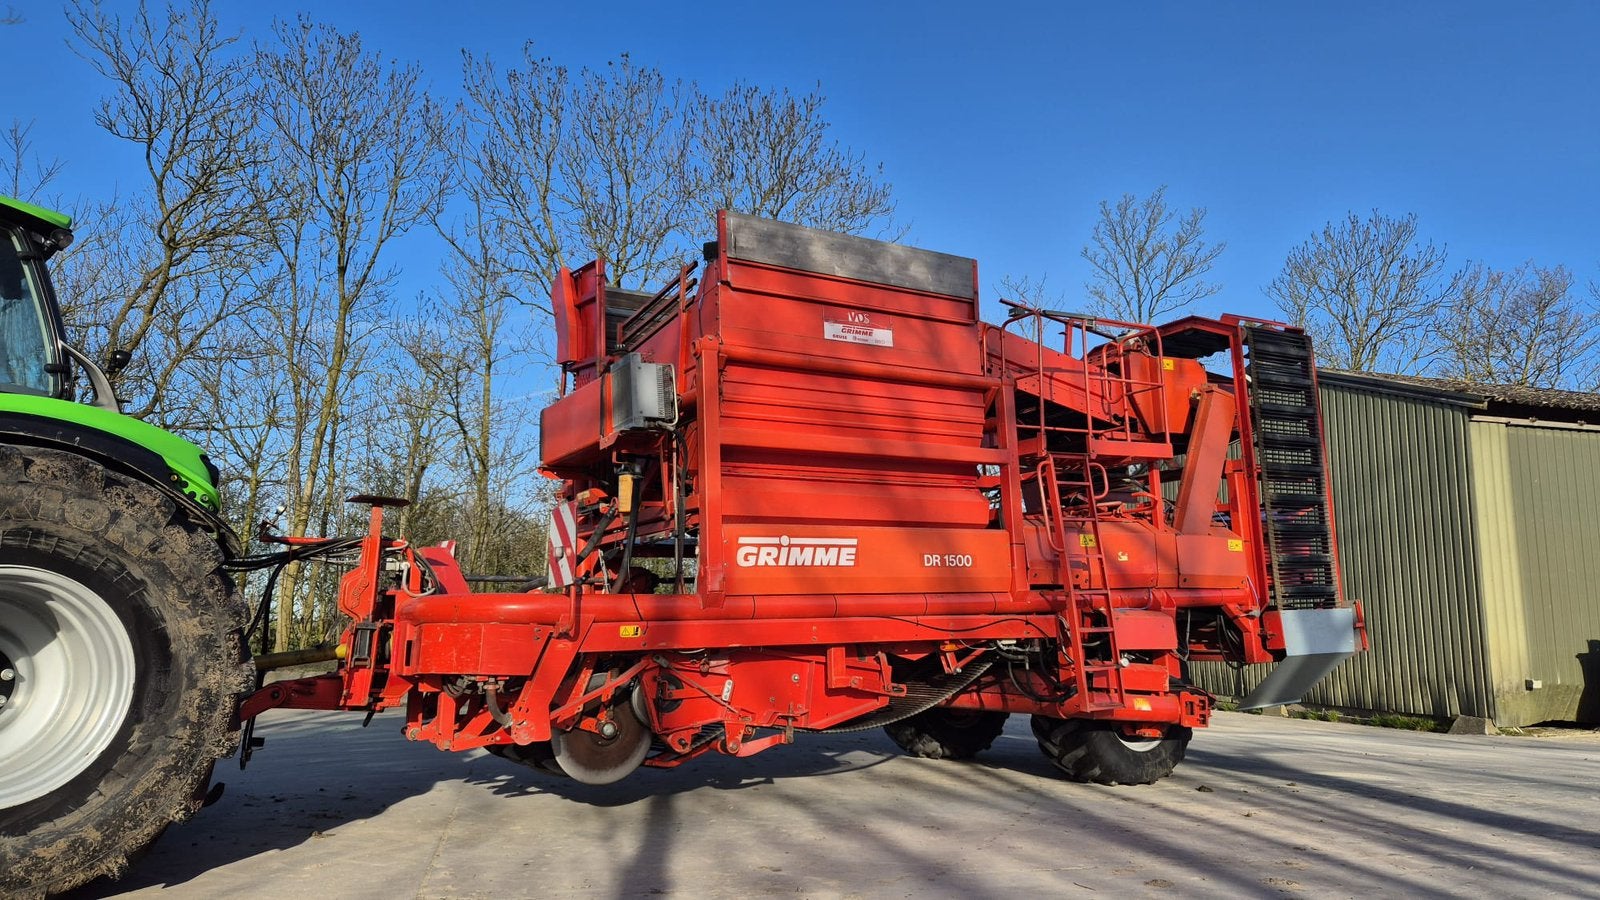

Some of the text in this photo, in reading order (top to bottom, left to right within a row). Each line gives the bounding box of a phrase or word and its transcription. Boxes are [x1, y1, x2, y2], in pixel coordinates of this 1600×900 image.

[841, 327, 874, 336] GRIMME
[736, 535, 858, 567] GRIMME
[924, 554, 972, 567] DR 1500
